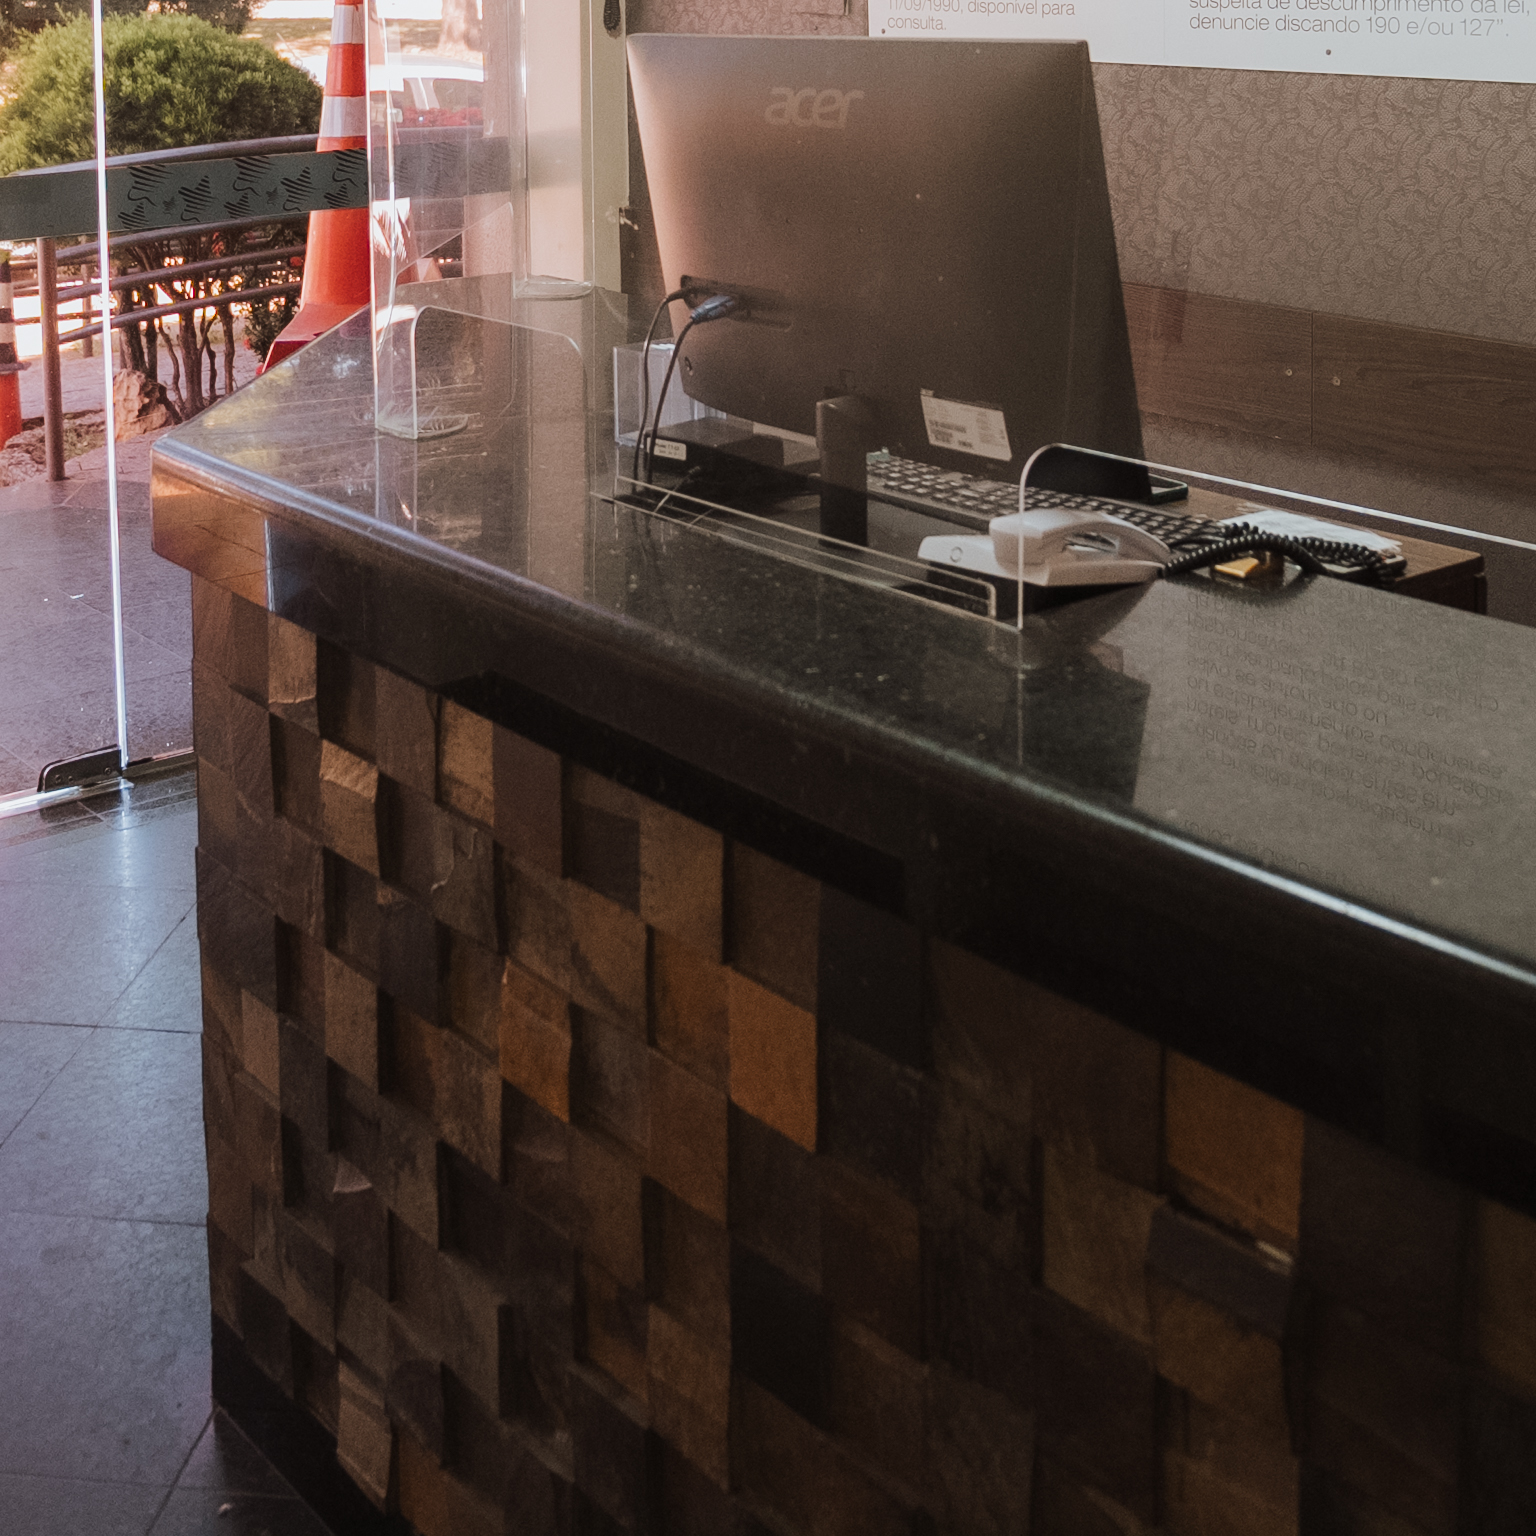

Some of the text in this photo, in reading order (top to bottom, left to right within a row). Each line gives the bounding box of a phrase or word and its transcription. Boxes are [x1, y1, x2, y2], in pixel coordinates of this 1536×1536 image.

[1041, 2, 1076, 19] para
[887, 15, 947, 31] consulta.
[764, 87, 866, 129] acer
